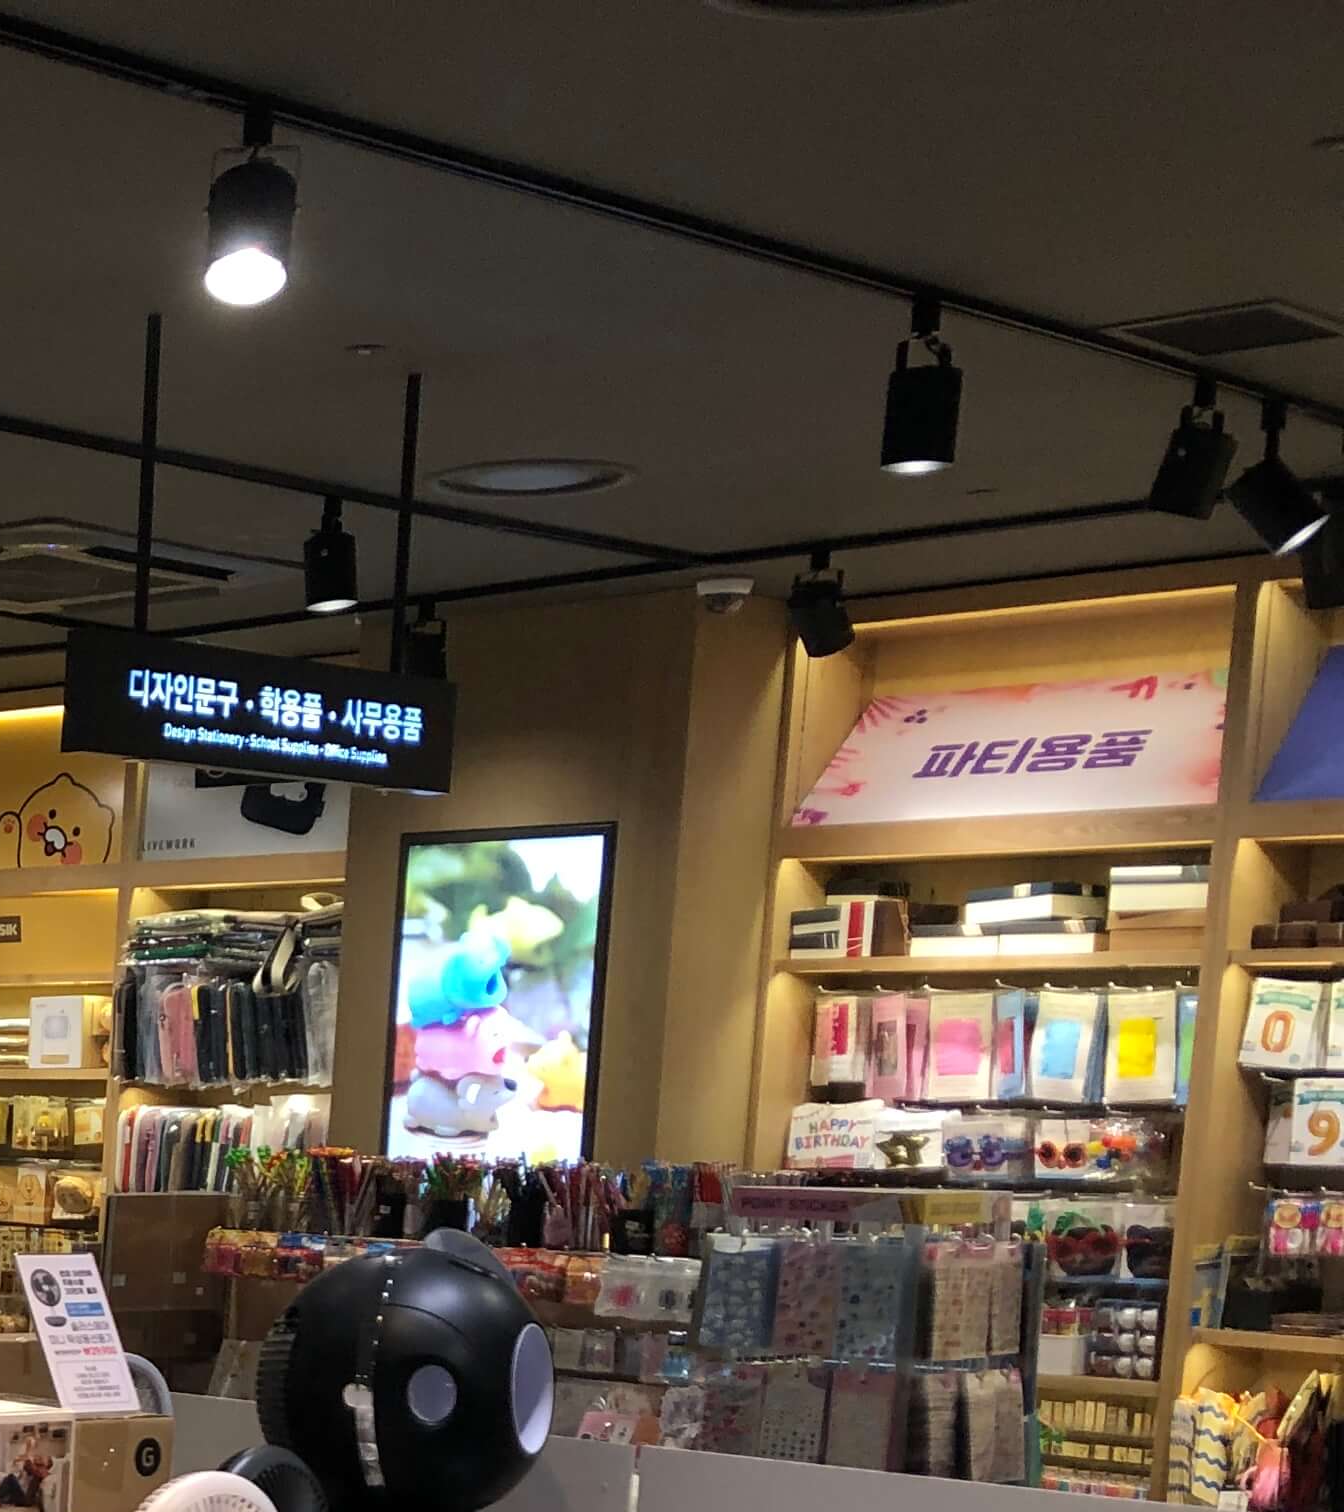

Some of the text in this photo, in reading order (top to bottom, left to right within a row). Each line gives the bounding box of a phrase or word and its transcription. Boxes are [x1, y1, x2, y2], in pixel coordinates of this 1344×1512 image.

[128, 669, 423, 742] 디자인문구 학용품 사무용품
[163, 722, 197, 744] Design
[197, 726, 245, 750] Stationery
[250, 733, 281, 750] School
[281, 737, 319, 756] Supplies
[351, 747, 388, 764] Supplies
[912, 729, 1153, 778] 파티용품
[808, 1118, 858, 1133] HAPPY
[794, 1133, 869, 1151] BIRTHDAY
[140, 1446, 155, 1468] G
